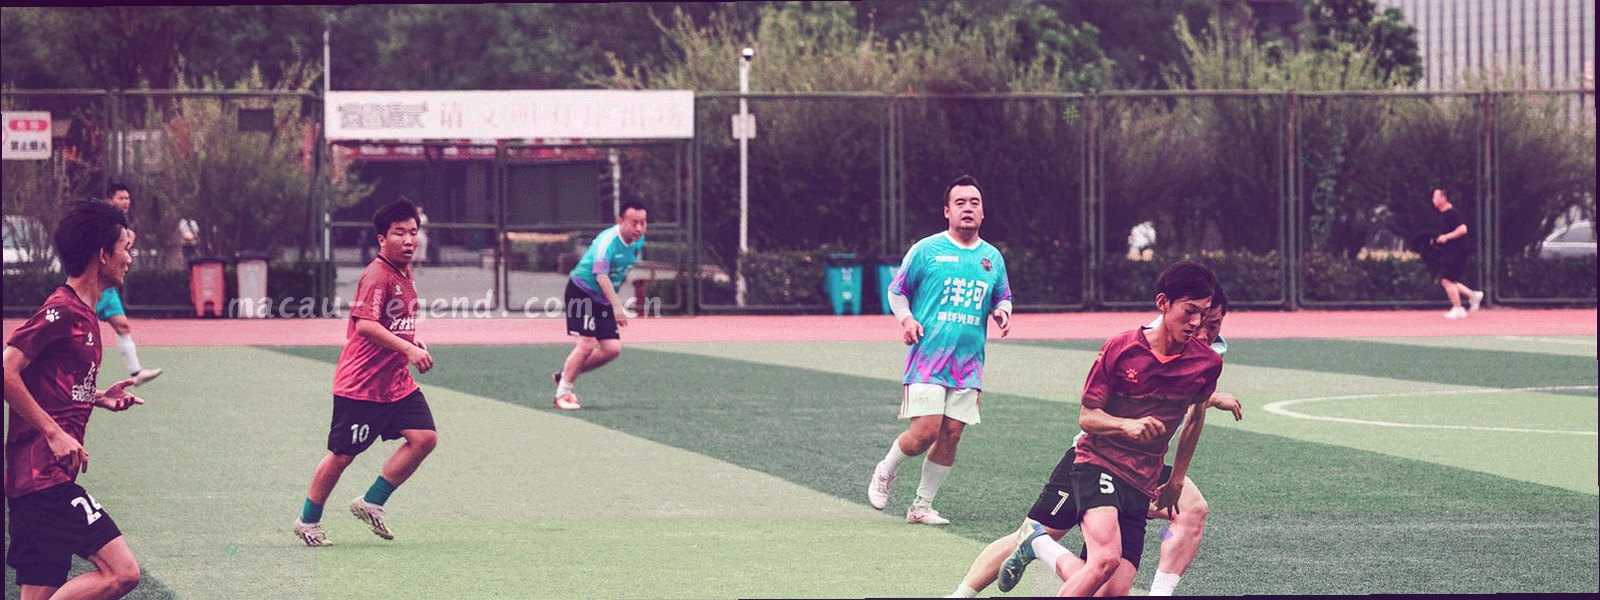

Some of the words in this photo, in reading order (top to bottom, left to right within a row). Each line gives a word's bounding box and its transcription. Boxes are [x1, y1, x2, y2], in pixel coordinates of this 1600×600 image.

[940, 277, 989, 310] 洋河
[583, 314, 596, 331] 16
[350, 423, 370, 445] 10
[1099, 472, 1115, 494] 5
[1050, 490, 1069, 516] 7
